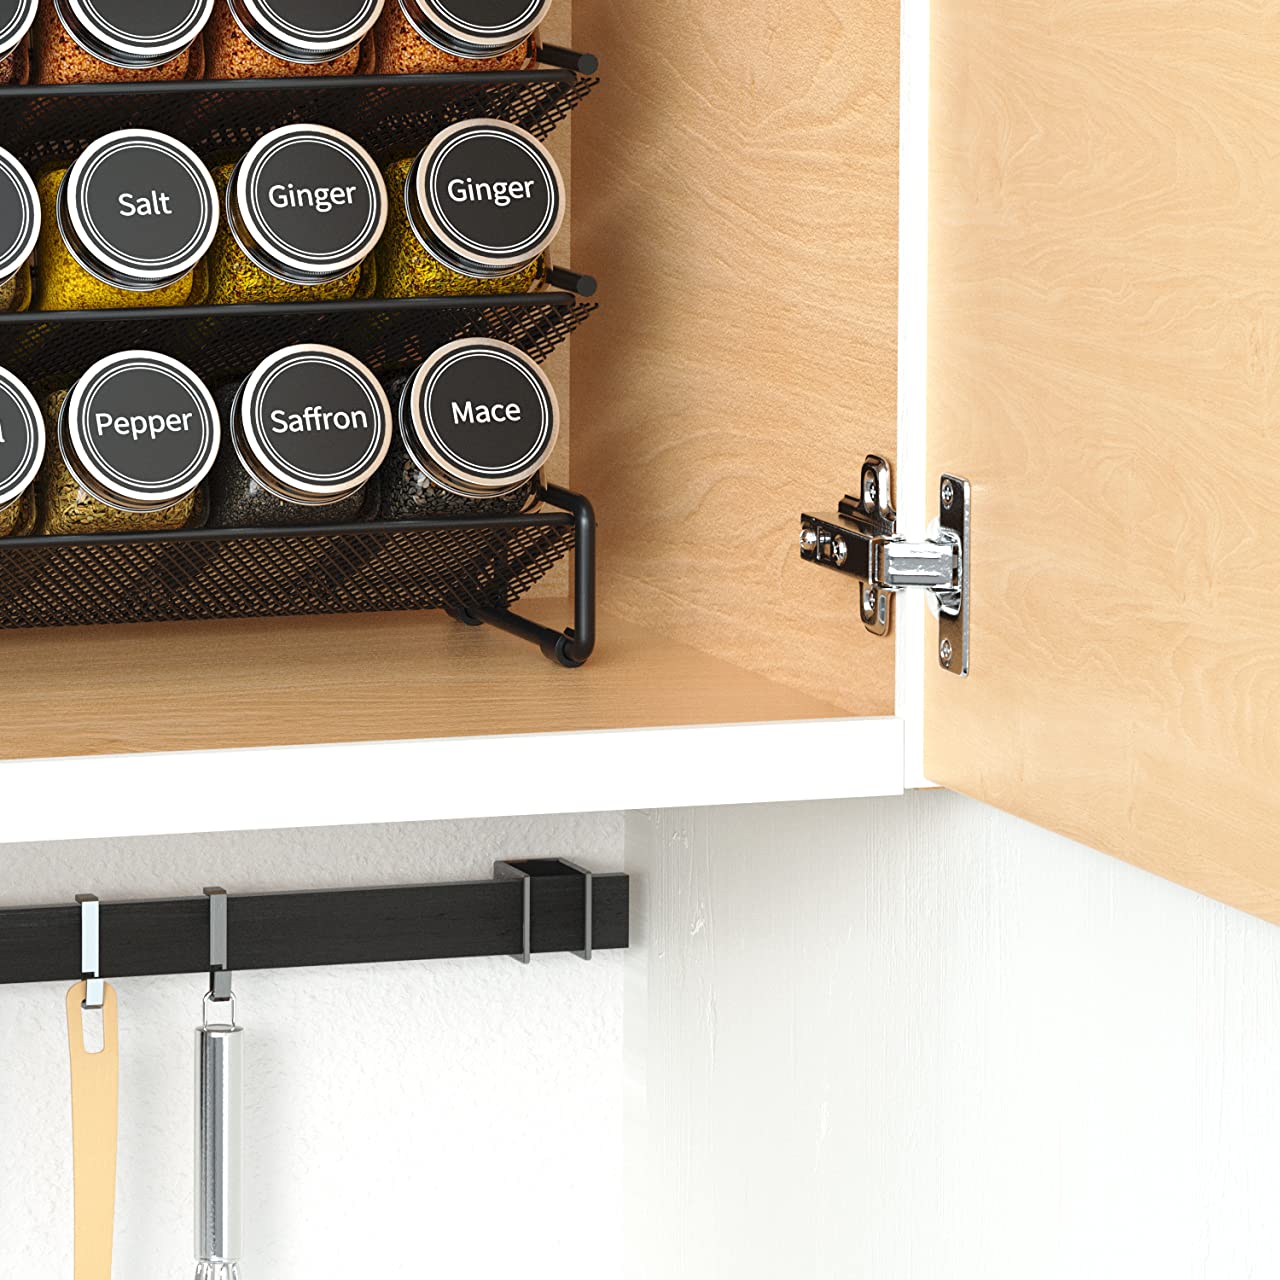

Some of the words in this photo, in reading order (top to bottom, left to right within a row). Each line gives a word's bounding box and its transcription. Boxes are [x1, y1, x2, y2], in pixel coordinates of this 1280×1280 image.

[118, 189, 173, 217] Salt
[268, 183, 357, 213] Ginger
[447, 177, 535, 207] Ginger
[95, 412, 193, 441] Pepper
[270, 405, 368, 434] Saffron
[451, 400, 521, 425] Mace
